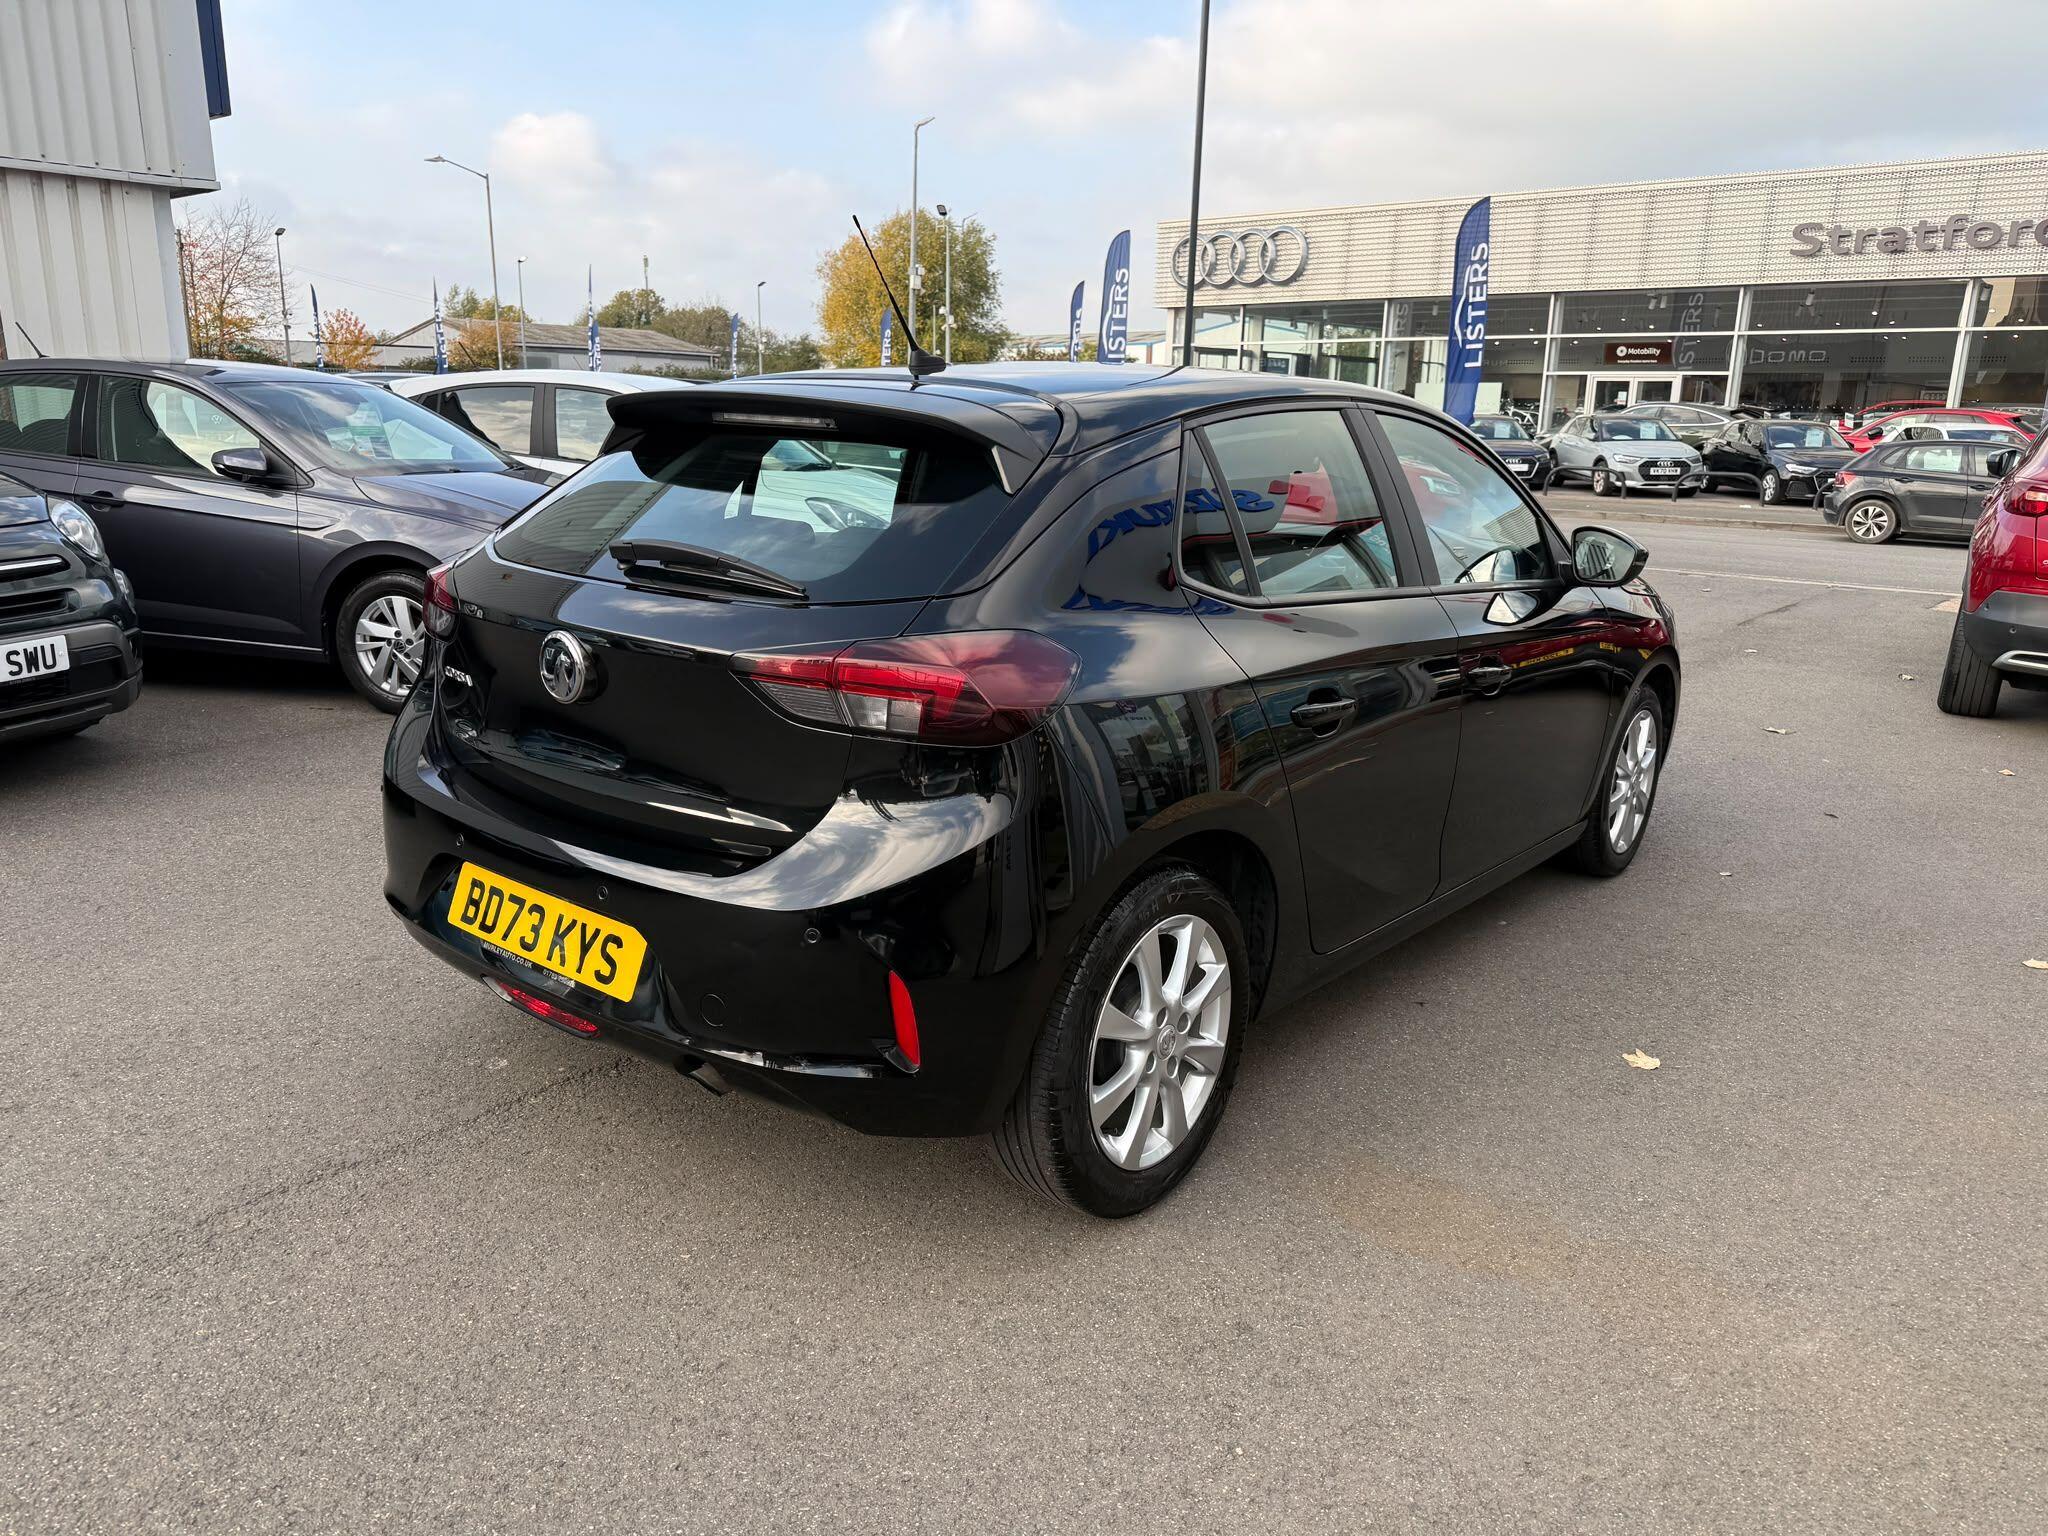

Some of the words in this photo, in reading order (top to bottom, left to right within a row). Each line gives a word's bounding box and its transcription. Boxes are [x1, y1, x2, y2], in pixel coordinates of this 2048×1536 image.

[1107, 267, 1129, 359] ISTERS
[1464, 242, 1489, 369] LISTERS
[881, 329, 892, 367] TERS
[1627, 347, 1661, 357] Motability
[5, 643, 57, 677] SWU
[460, 877, 546, 953] BD73
[546, 913, 624, 986] KYS
